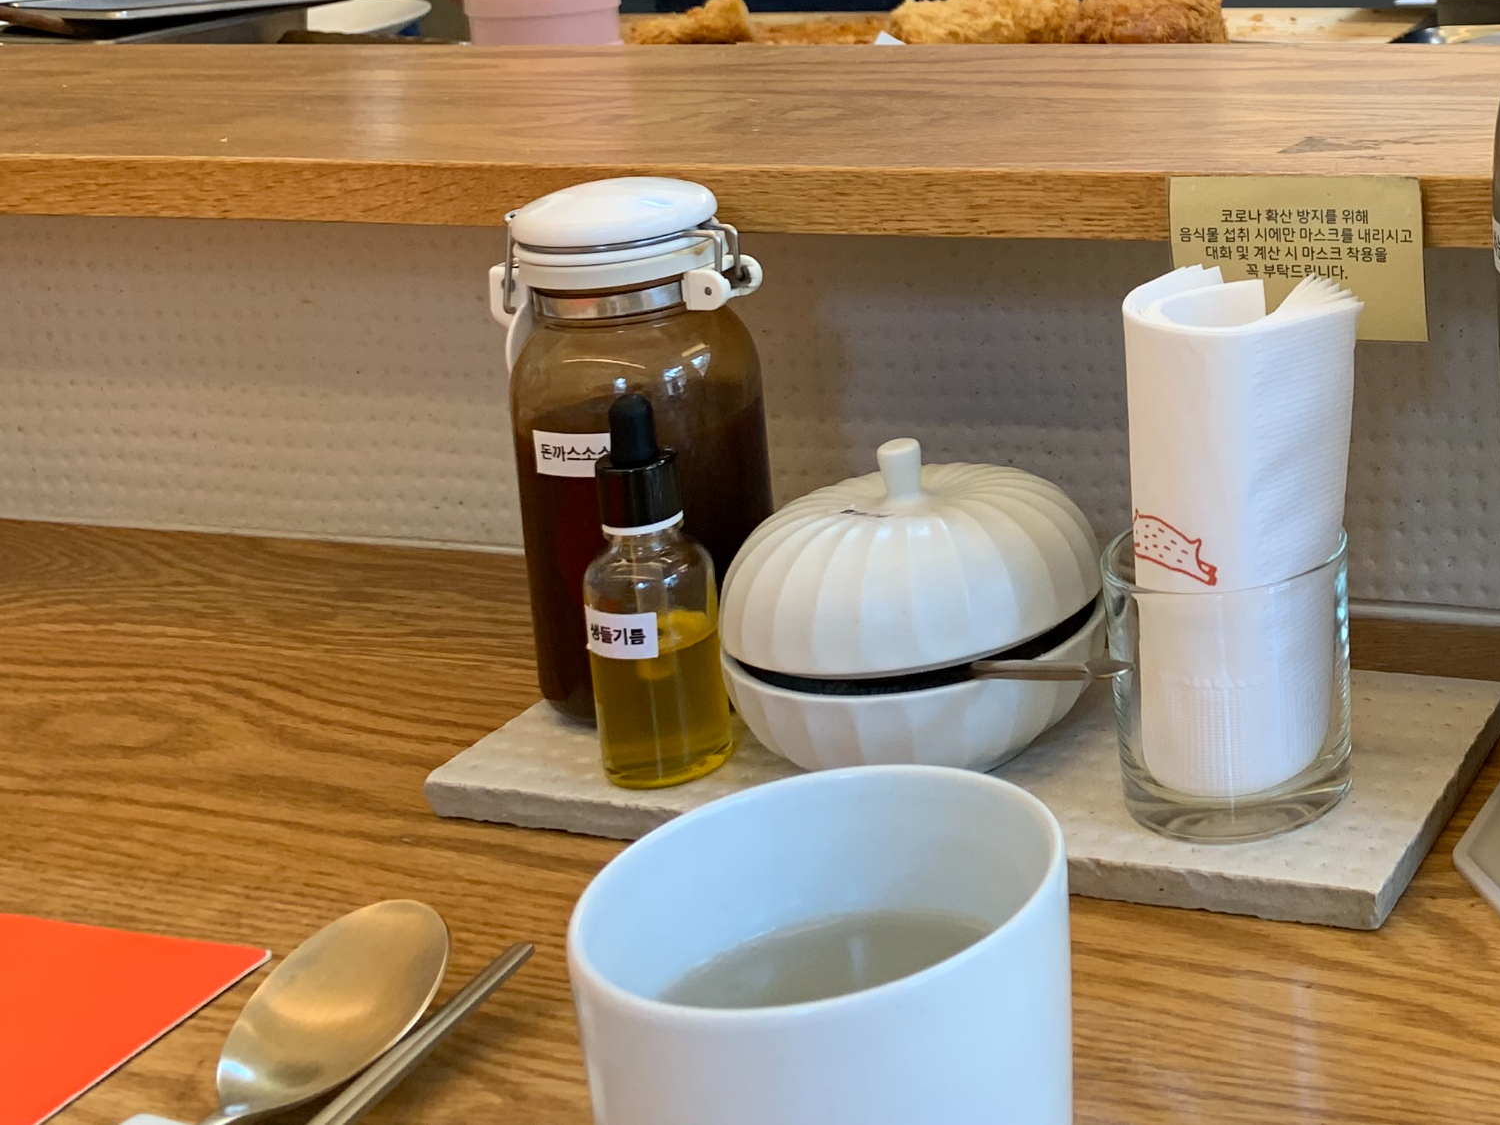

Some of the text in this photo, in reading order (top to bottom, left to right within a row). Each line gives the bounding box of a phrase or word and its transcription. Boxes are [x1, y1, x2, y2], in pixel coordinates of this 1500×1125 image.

[1220, 209, 1369, 225] 코로나 확산 방지를 위해
[1179, 227, 1414, 244] 음식물 섭취 시에만 마스크를 내리시고
[1205, 245, 1388, 263] 대화 및 계산 시 마스크 착용을
[1246, 263, 1259, 278] 꼭
[590, 623, 646, 646] 생들기름
